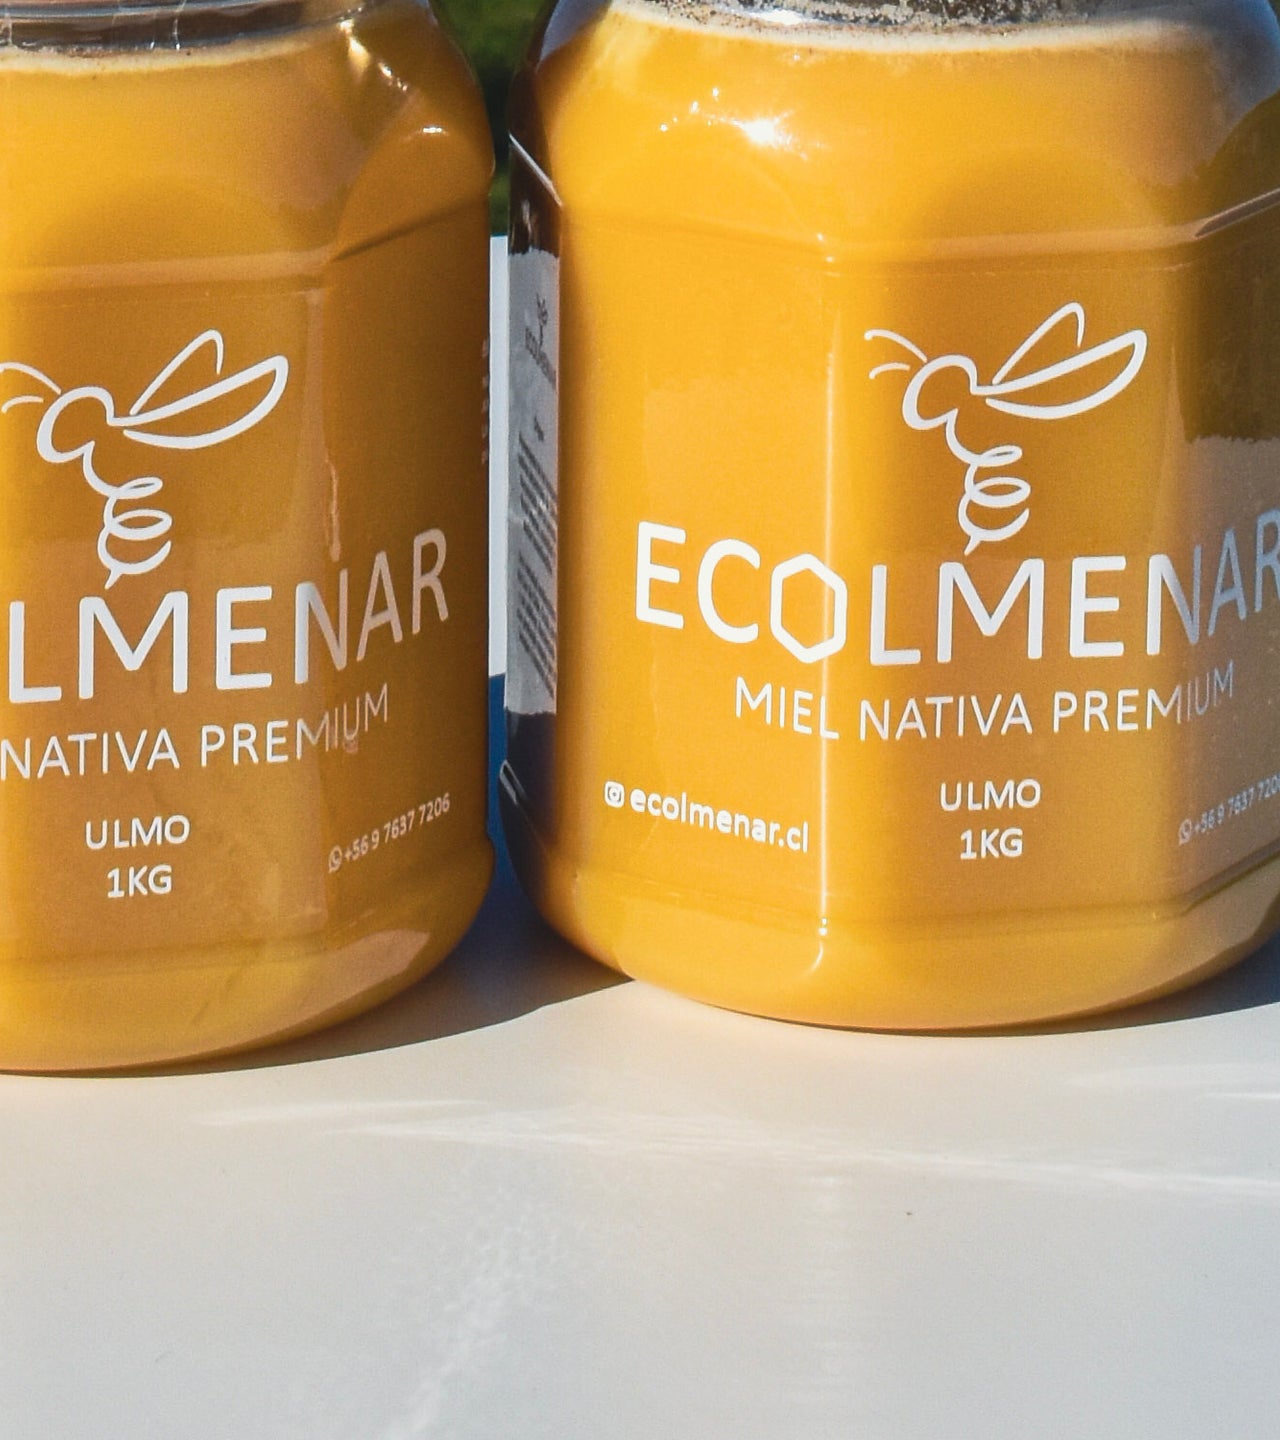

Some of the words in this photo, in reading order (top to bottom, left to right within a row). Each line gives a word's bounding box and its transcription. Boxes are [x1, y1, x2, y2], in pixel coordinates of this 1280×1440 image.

[735, 675, 840, 741] MIEL
[860, 687, 1032, 741] NATIVA
[1053, 659, 1235, 733] PREMIUM
[0, 727, 180, 782] NATIVA
[200, 682, 389, 769] PREMIUM
[939, 777, 1042, 813] ULMO
[85, 814, 191, 852] ULMO
[344, 835, 369, 862] +56
[371, 829, 380, 850] 9
[384, 810, 415, 843] 7637
[419, 792, 450, 826] 7206
[959, 826, 1023, 860] 1KG
[106, 865, 174, 899] 1KG
